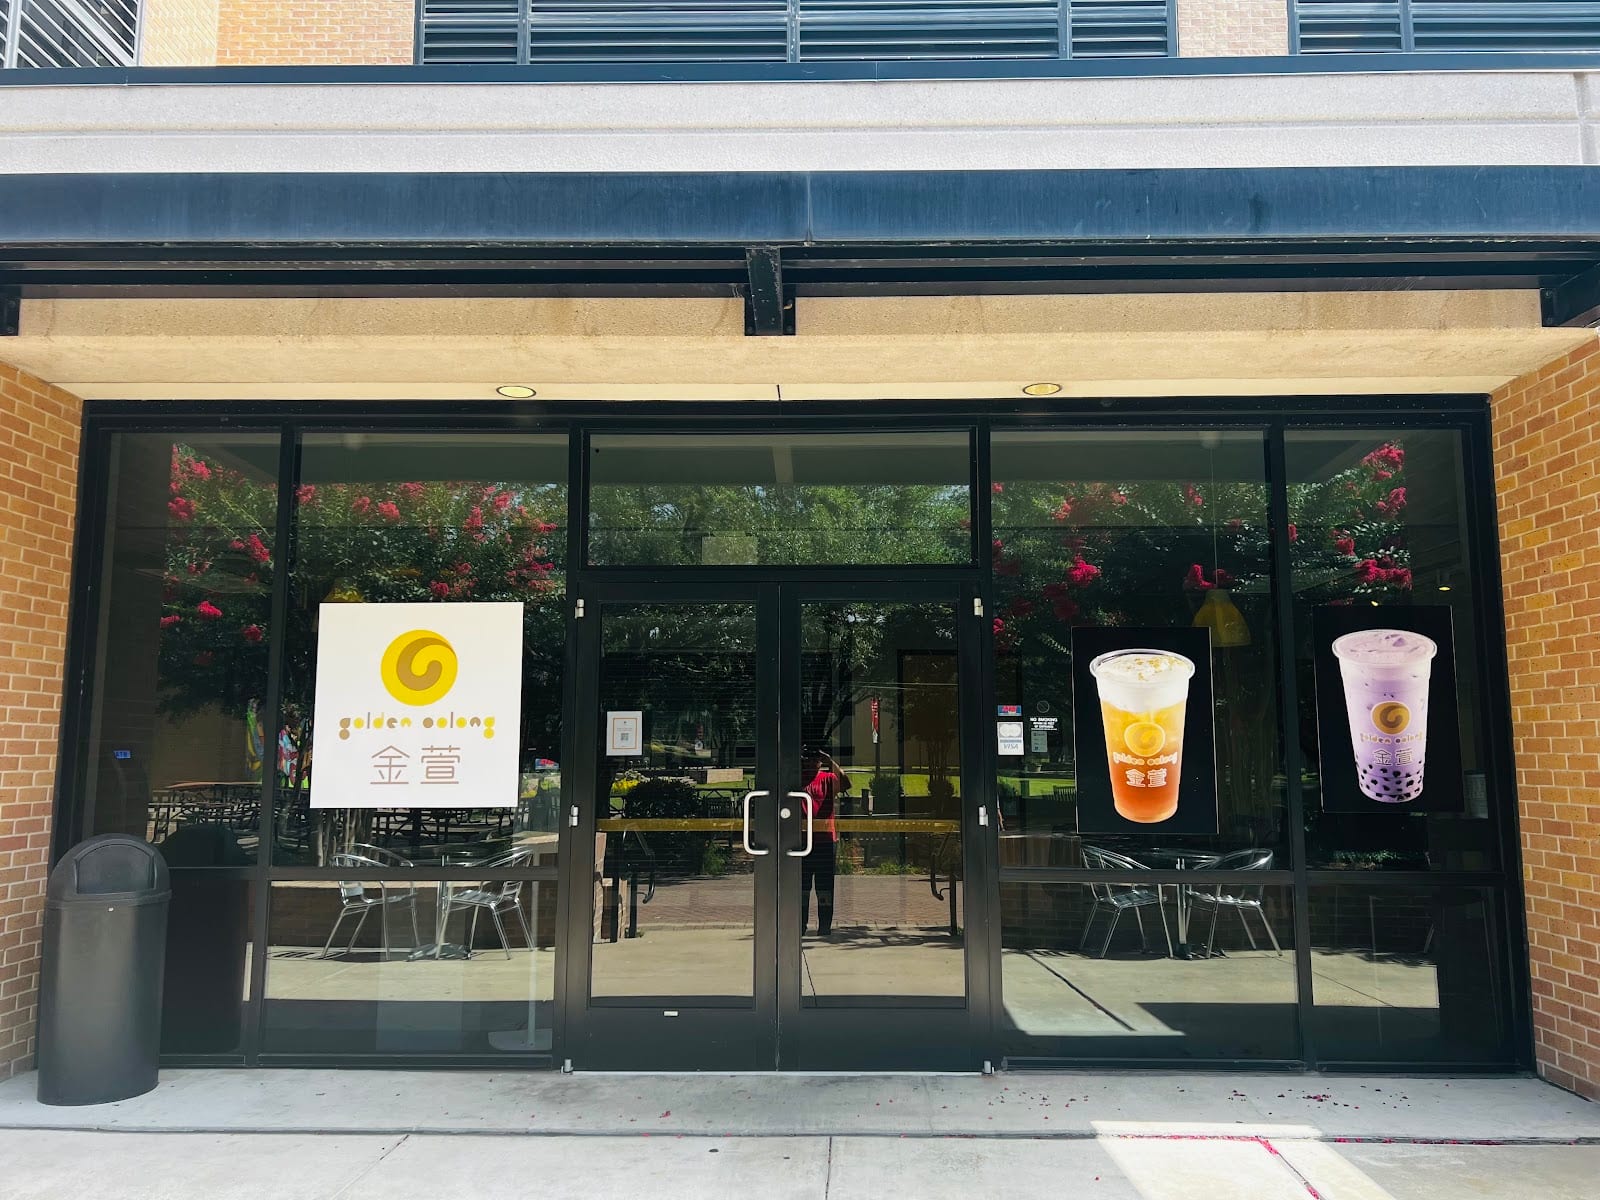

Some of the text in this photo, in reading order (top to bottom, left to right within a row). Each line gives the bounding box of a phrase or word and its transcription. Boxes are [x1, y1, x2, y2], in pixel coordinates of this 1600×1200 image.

[339, 711, 496, 741] golden oolong
[370, 744, 461, 785] 金萱
